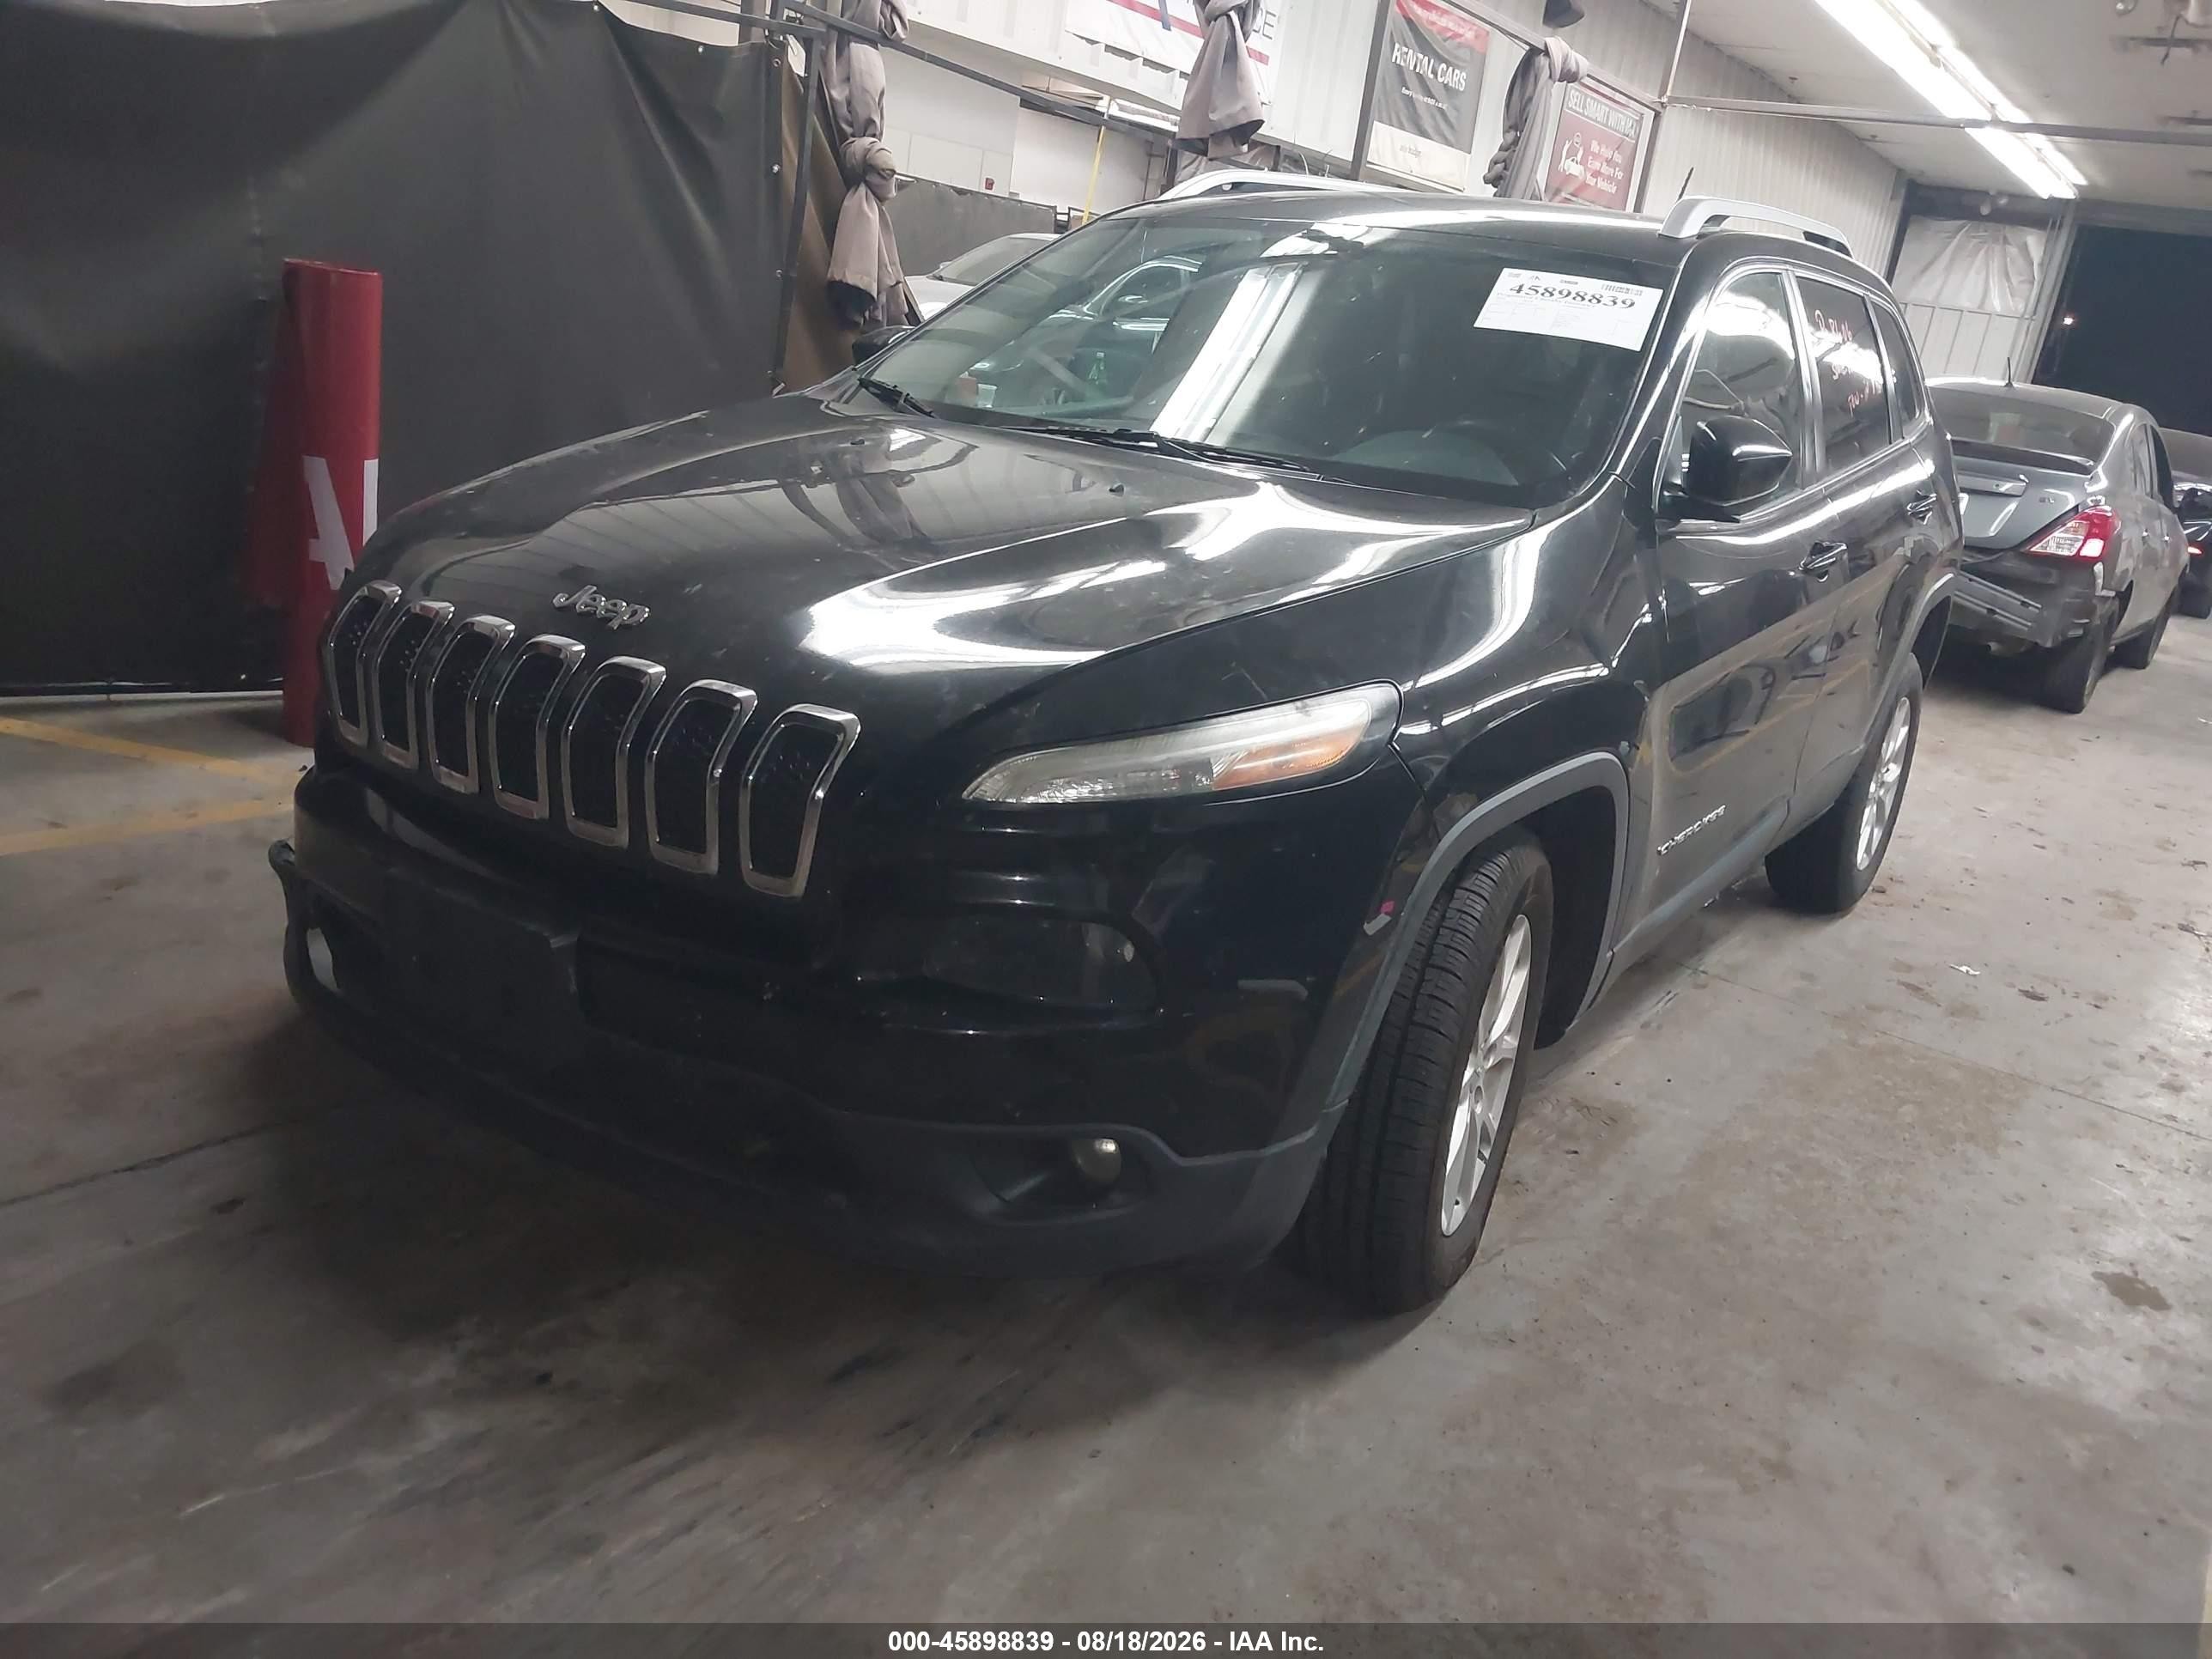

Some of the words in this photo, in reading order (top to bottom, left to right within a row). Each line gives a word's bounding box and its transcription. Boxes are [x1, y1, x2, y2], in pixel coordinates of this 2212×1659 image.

[1392, 42, 1434, 79] RENTAL
[1437, 63, 1467, 91] CARS
[1568, 88, 1583, 112] SELL
[1584, 97, 1609, 125] SMART
[1597, 176, 1617, 194] Vehicle
[1614, 167, 1624, 180] For
[1510, 283, 1635, 309] 45898839
[552, 585, 650, 630] Jeep
[1656, 805, 1727, 856] CHEROKEE
